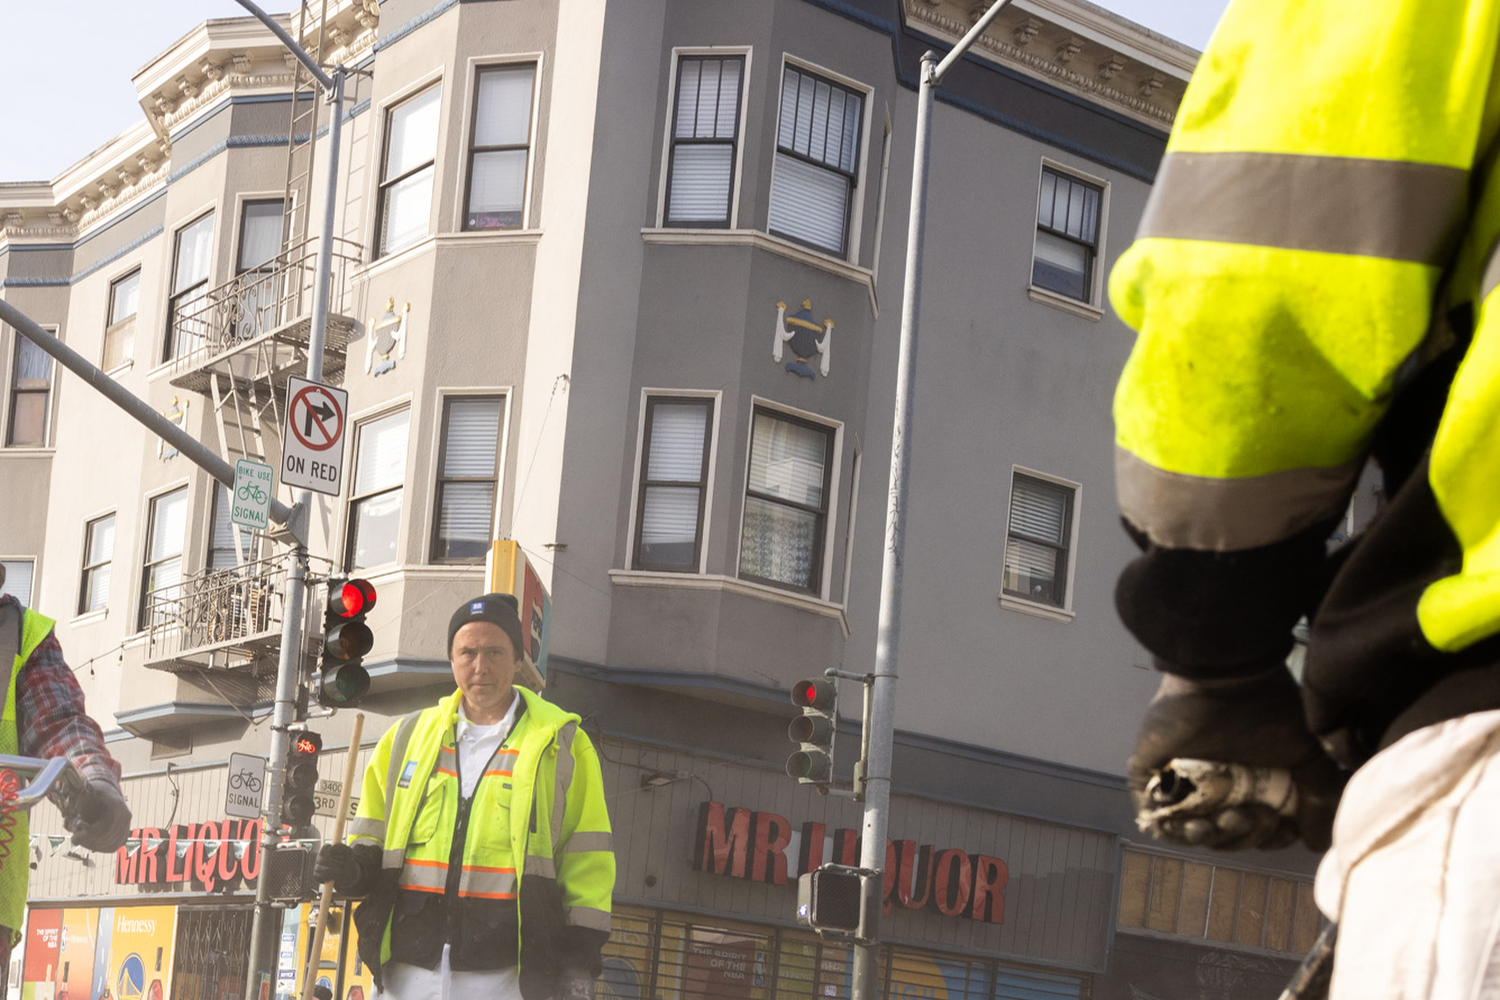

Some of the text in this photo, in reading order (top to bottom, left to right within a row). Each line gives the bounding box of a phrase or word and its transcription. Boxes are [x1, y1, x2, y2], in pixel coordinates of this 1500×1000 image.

[238, 466, 270, 481] BIKE USE
[286, 455, 337, 482] ON RED
[234, 506, 265, 523] SIGNAL
[228, 793, 259, 809] SIGNAL
[313, 796, 336, 810] 3RD
[701, 801, 792, 885] MR
[115, 819, 268, 892] MR LIQUO
[117, 915, 157, 936] Hennessy
[710, 959, 746, 972] OF THE
[723, 971, 745, 980] NBA
